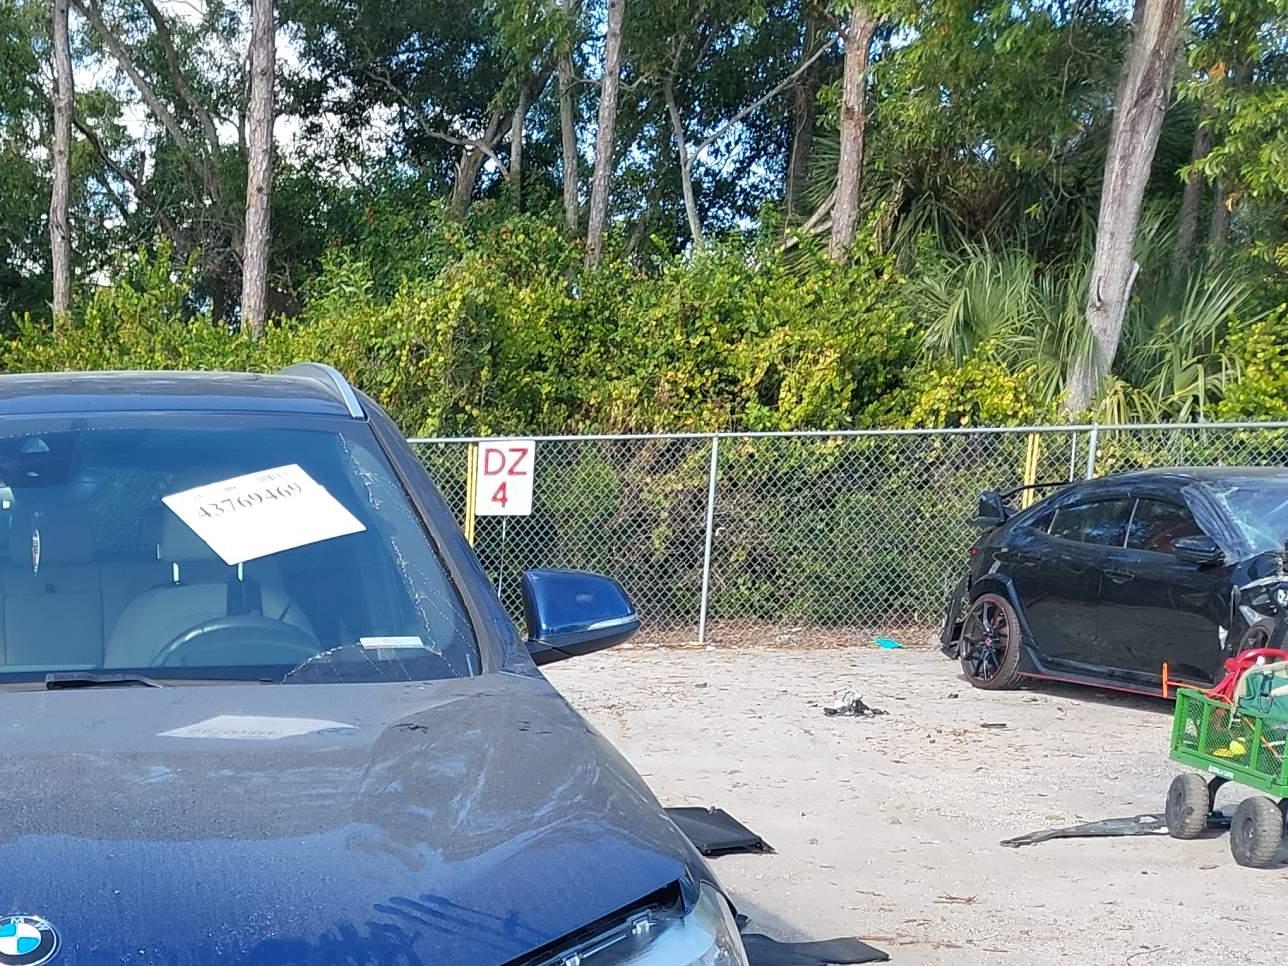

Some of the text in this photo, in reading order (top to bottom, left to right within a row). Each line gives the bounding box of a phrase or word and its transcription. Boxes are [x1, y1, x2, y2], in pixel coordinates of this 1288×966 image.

[484, 448, 529, 476] DZ
[198, 481, 303, 518] 43769469
[491, 481, 508, 508] 4
